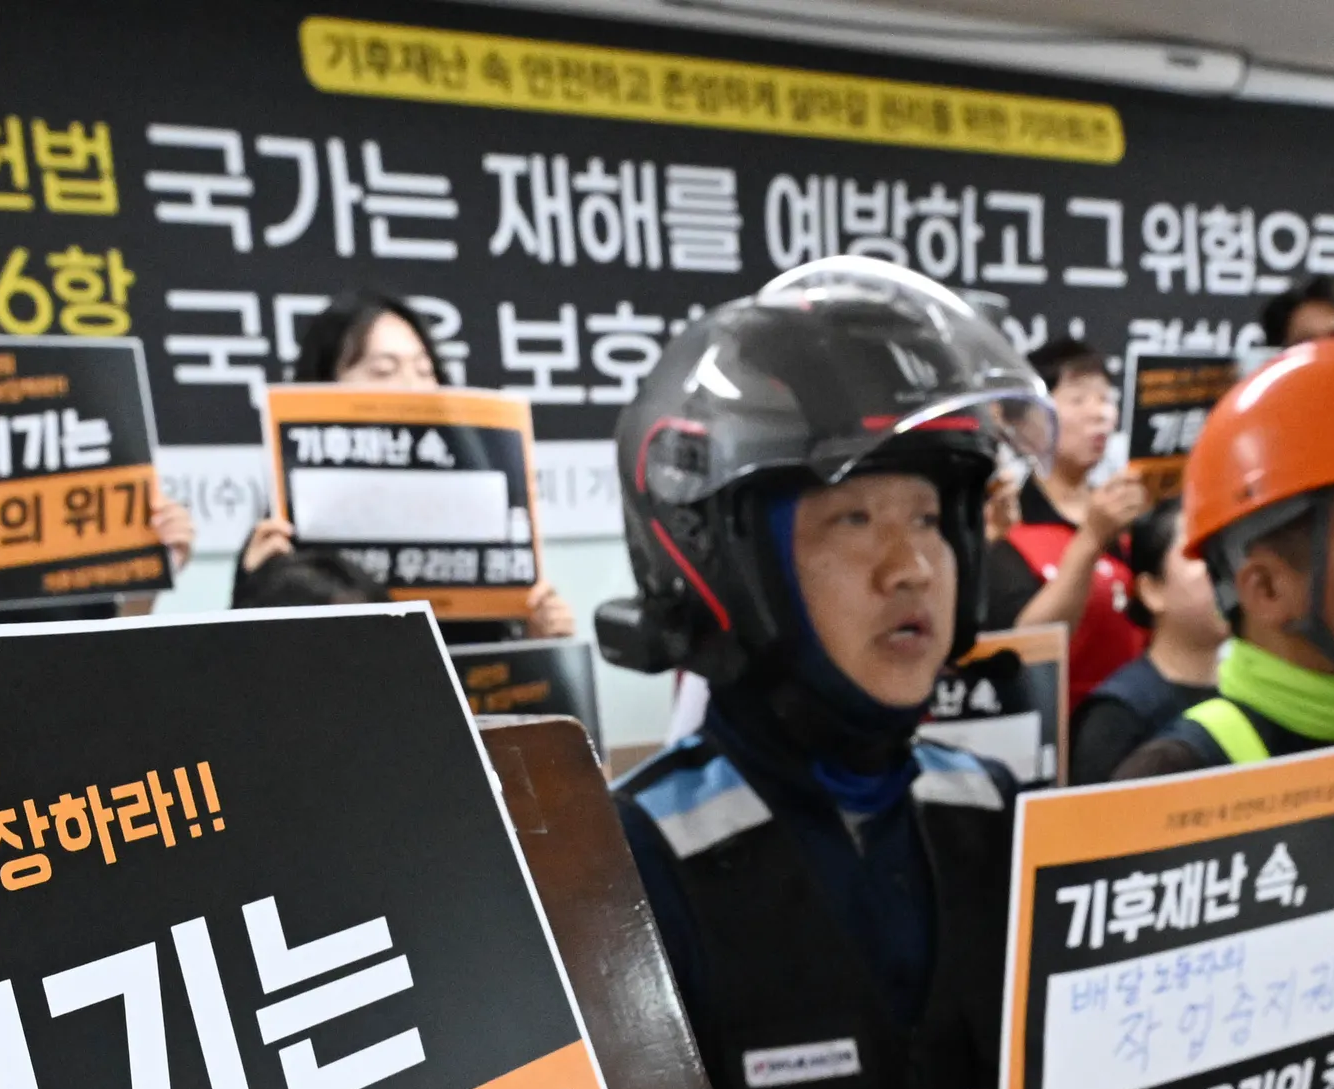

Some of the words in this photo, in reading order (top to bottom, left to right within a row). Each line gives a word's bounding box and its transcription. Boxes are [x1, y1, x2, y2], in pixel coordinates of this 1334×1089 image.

[324, 32, 470, 92] 기후재난
[145, 123, 459, 261] 국가는
[482, 151, 743, 273] 재해를
[764, 173, 1049, 284] 예방하고
[1062, 198, 1128, 287] 그
[287, 425, 413, 464] 기후재난
[64, 479, 152, 539] 위기
[1055, 851, 1248, 950] 기후재난
[1255, 841, 1308, 908] 속,
[1069, 965, 1144, 1014] 배달
